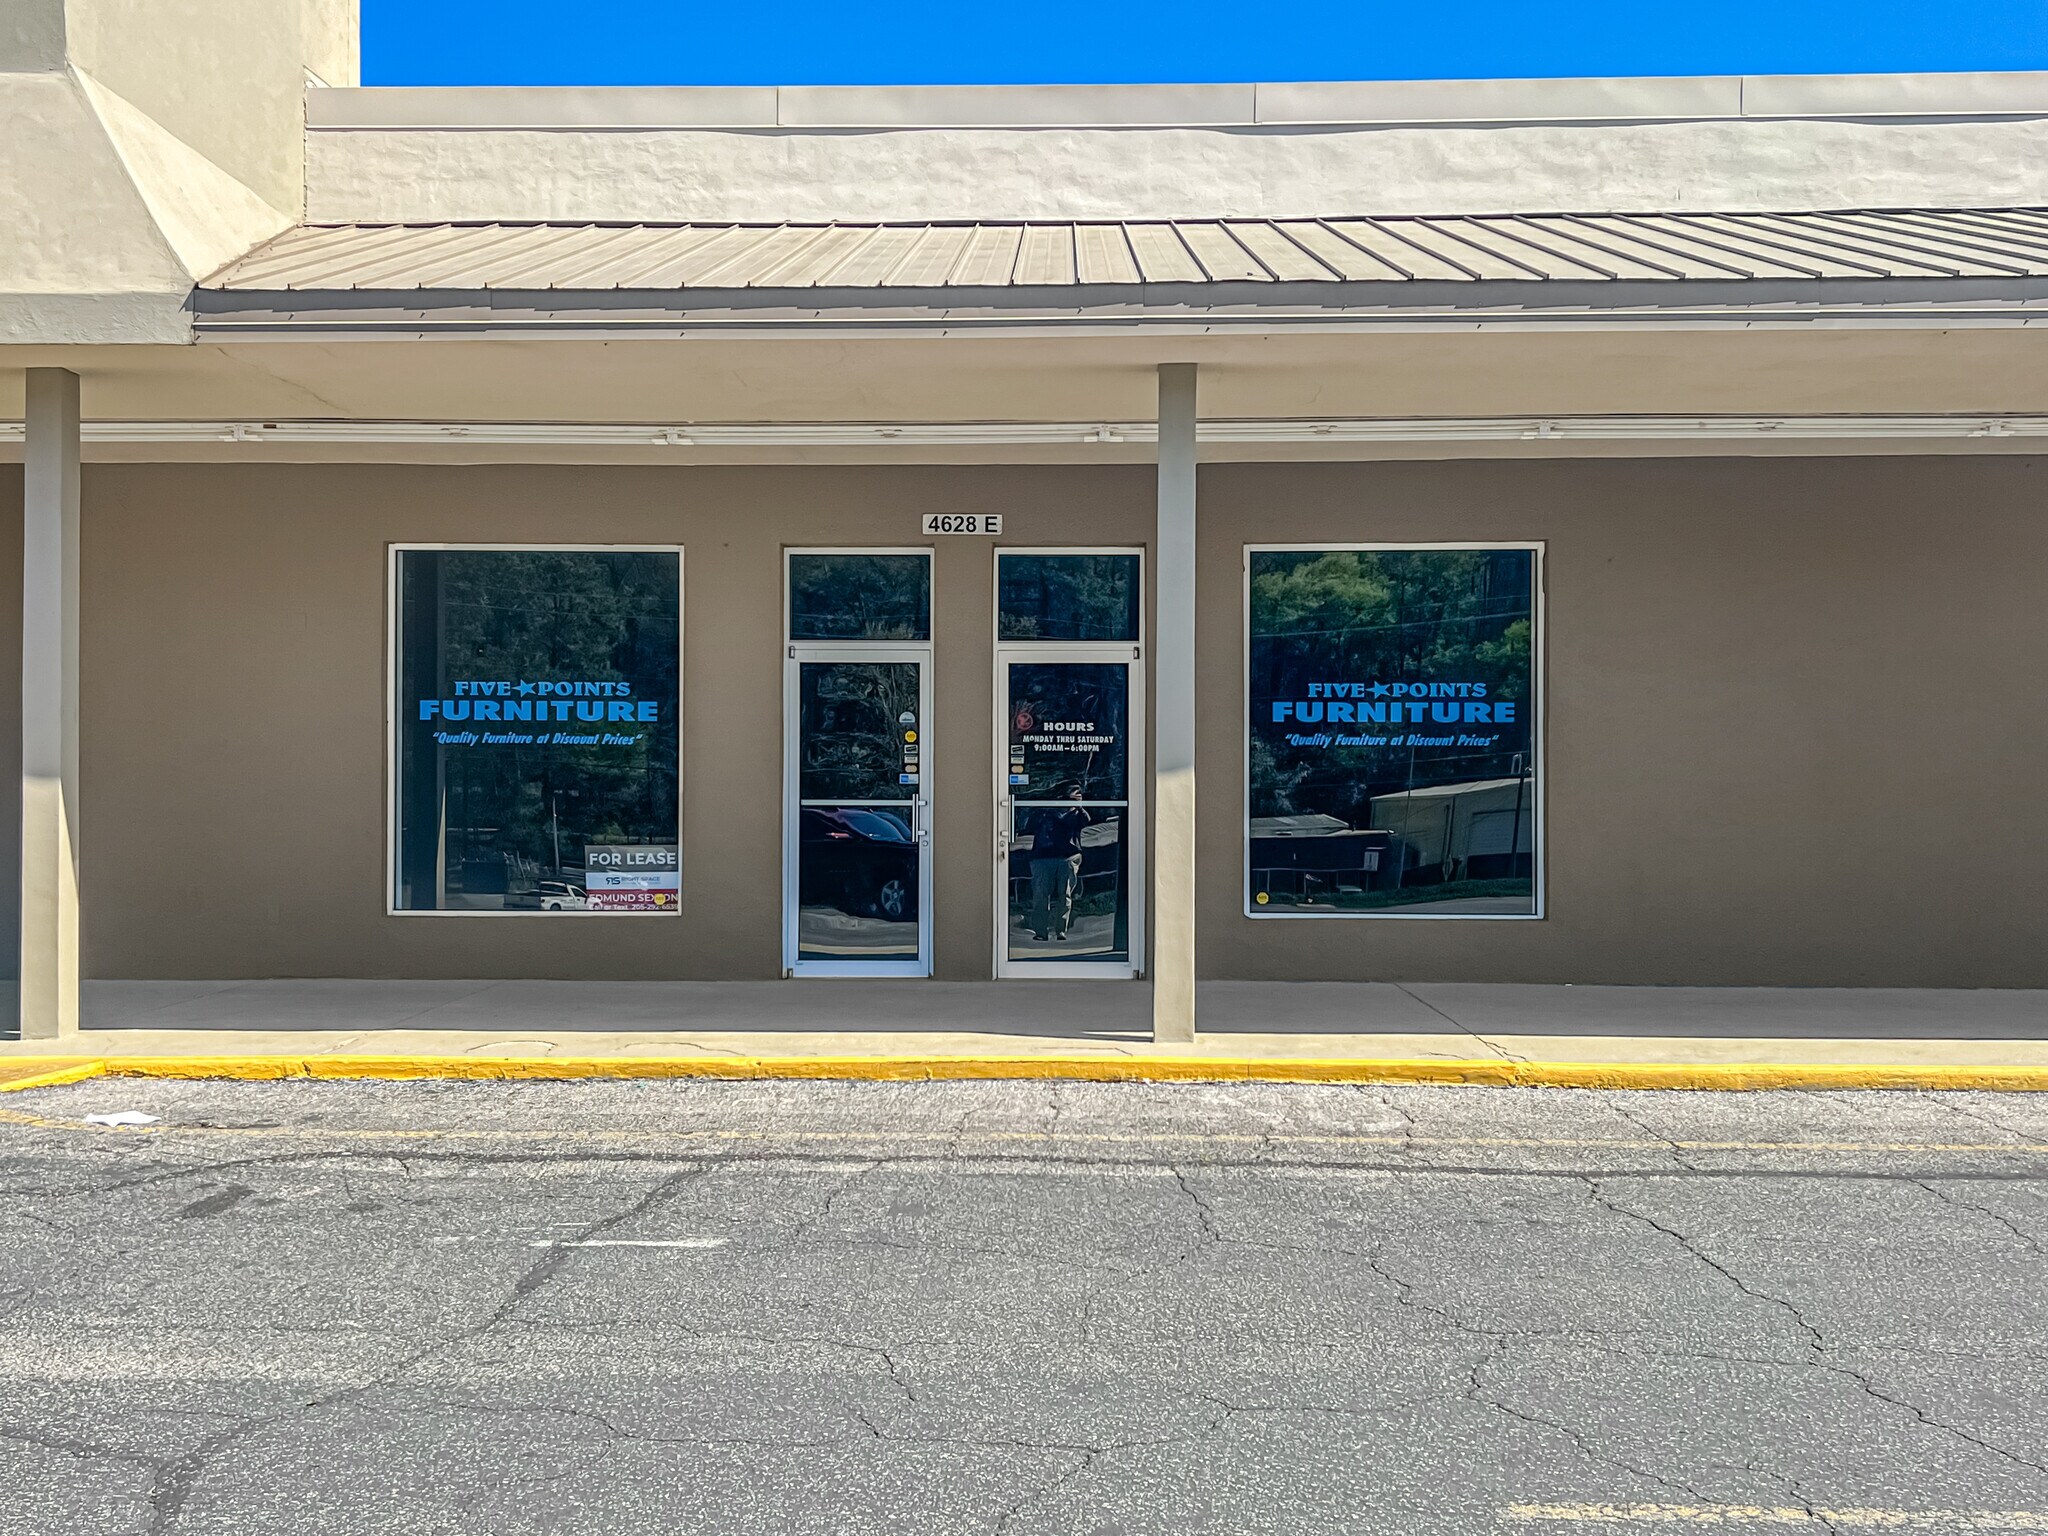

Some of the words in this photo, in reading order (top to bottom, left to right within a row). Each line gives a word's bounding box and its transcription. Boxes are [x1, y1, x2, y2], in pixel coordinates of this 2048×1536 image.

[928, 515, 977, 533] 4628
[985, 516, 998, 533] E
[454, 681, 511, 696] FIVE
[537, 681, 631, 697] POINTS
[1307, 682, 1365, 698] FIVE
[1392, 682, 1487, 698] POINTS
[419, 700, 658, 722] FURNITURE
[1272, 702, 1515, 723] FURNITURE
[1043, 722, 1095, 732] HOURS
[482, 732, 533, 745] Furniture
[537, 733, 550, 745] at
[552, 732, 599, 745] Discount
[1023, 735, 1054, 743] MONDAY
[1056, 735, 1075, 743] THRU
[1077, 735, 1114, 744] SATURDAY
[1335, 734, 1386, 746] Furniture
[1390, 734, 1404, 746] at
[1406, 734, 1454, 746] Discount
[589, 852, 622, 865] FOR
[626, 852, 676, 865] LEASE
[588, 893, 636, 902] EDMUND
[637, 893, 678, 902] SEXON
